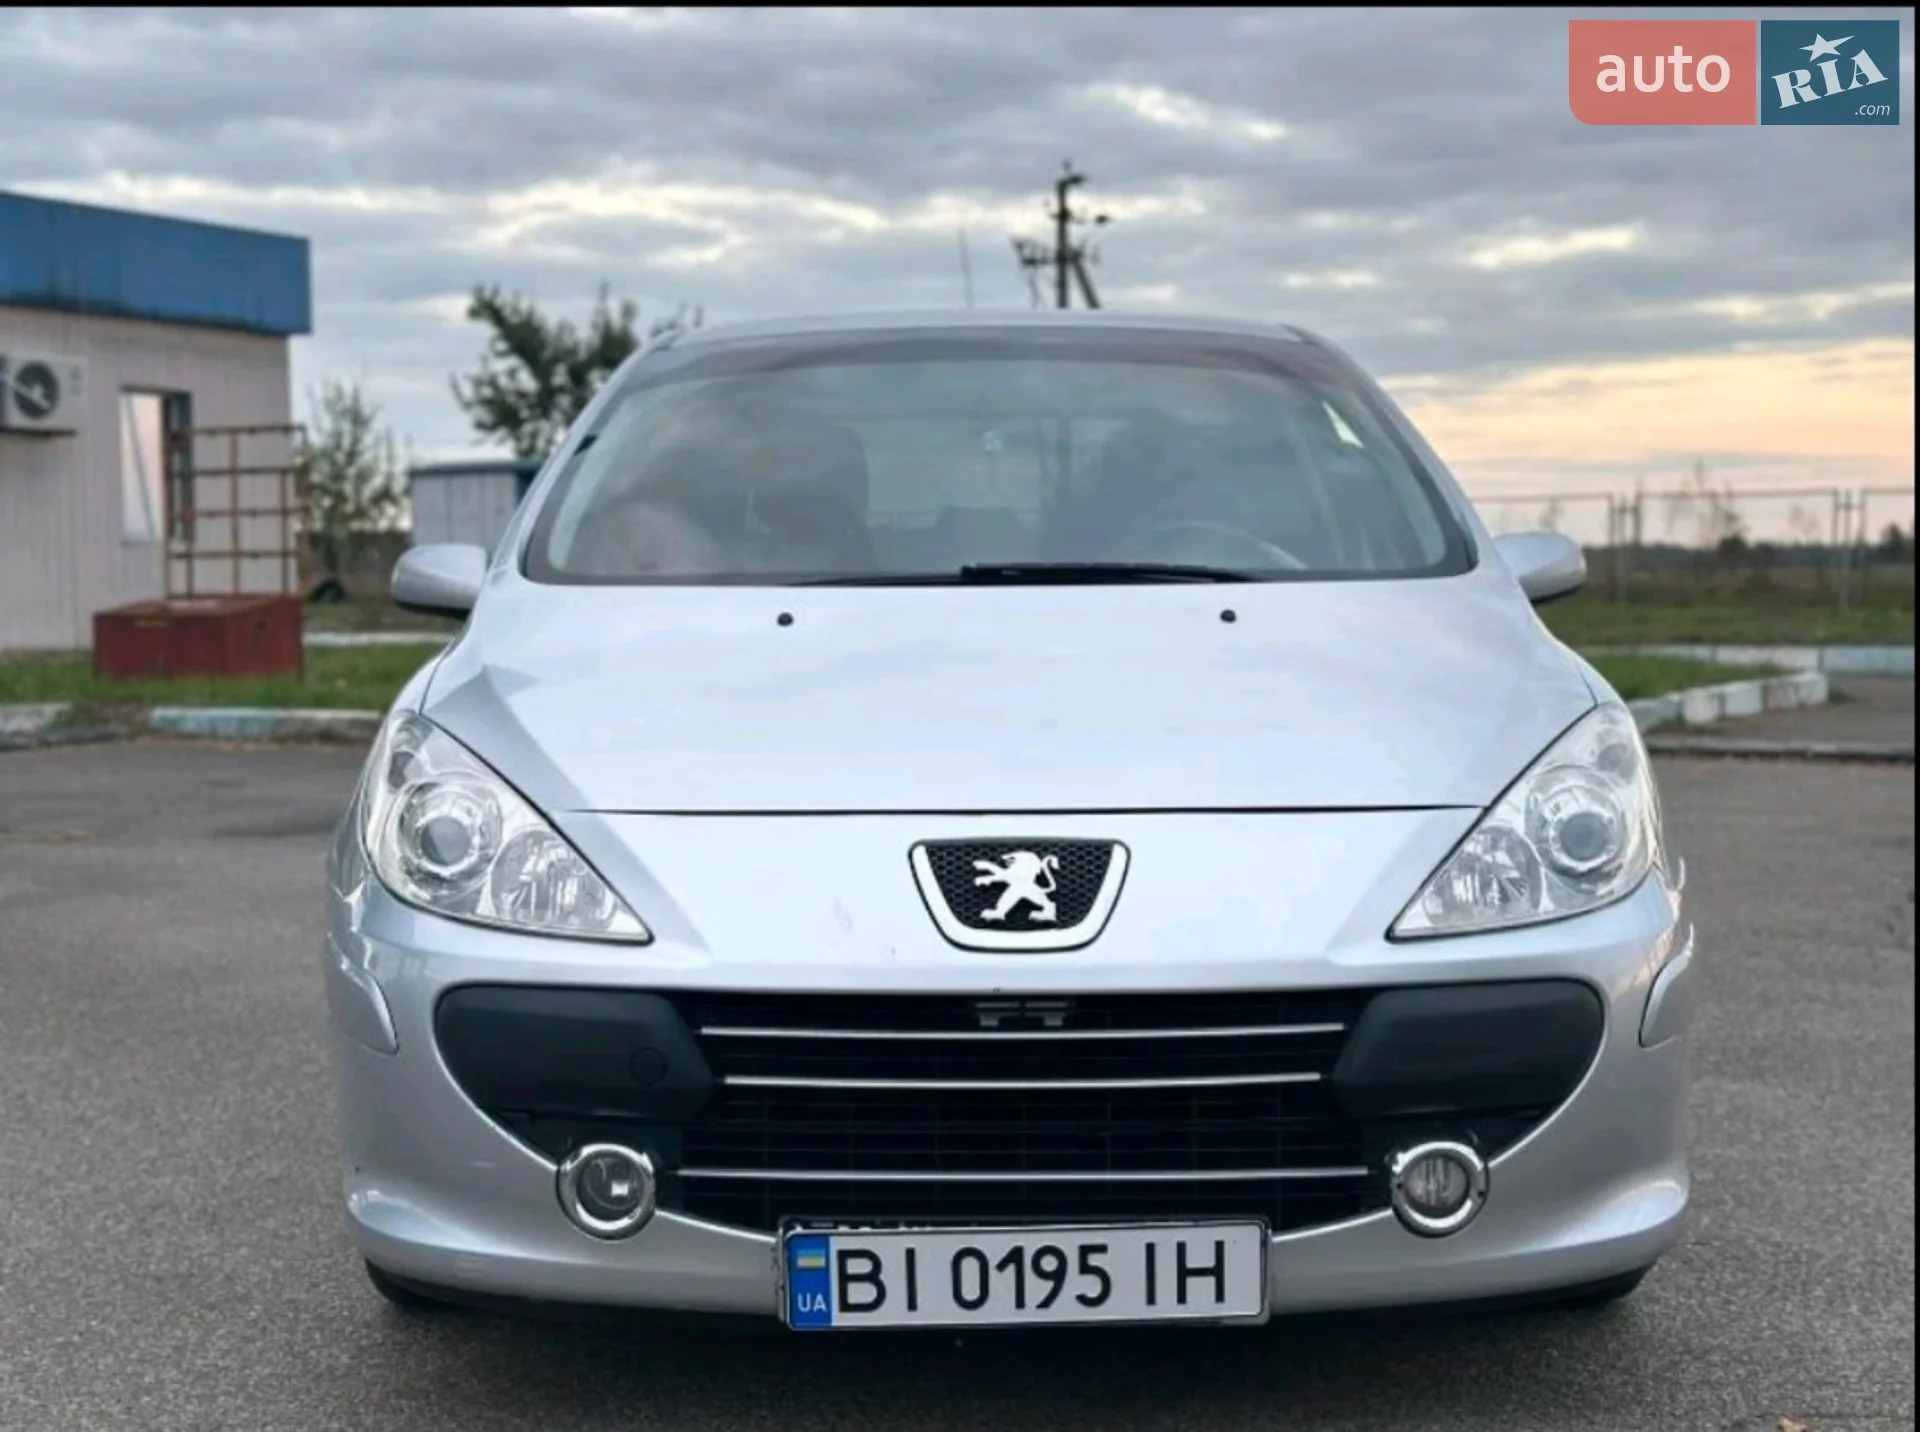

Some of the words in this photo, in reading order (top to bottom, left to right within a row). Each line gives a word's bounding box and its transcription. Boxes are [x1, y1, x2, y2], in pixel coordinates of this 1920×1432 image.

[837, 1247, 918, 1313] BI
[951, 1244, 1112, 1310] 0195
[1145, 1240, 1225, 1306] IH
[797, 1293, 827, 1313] UA
